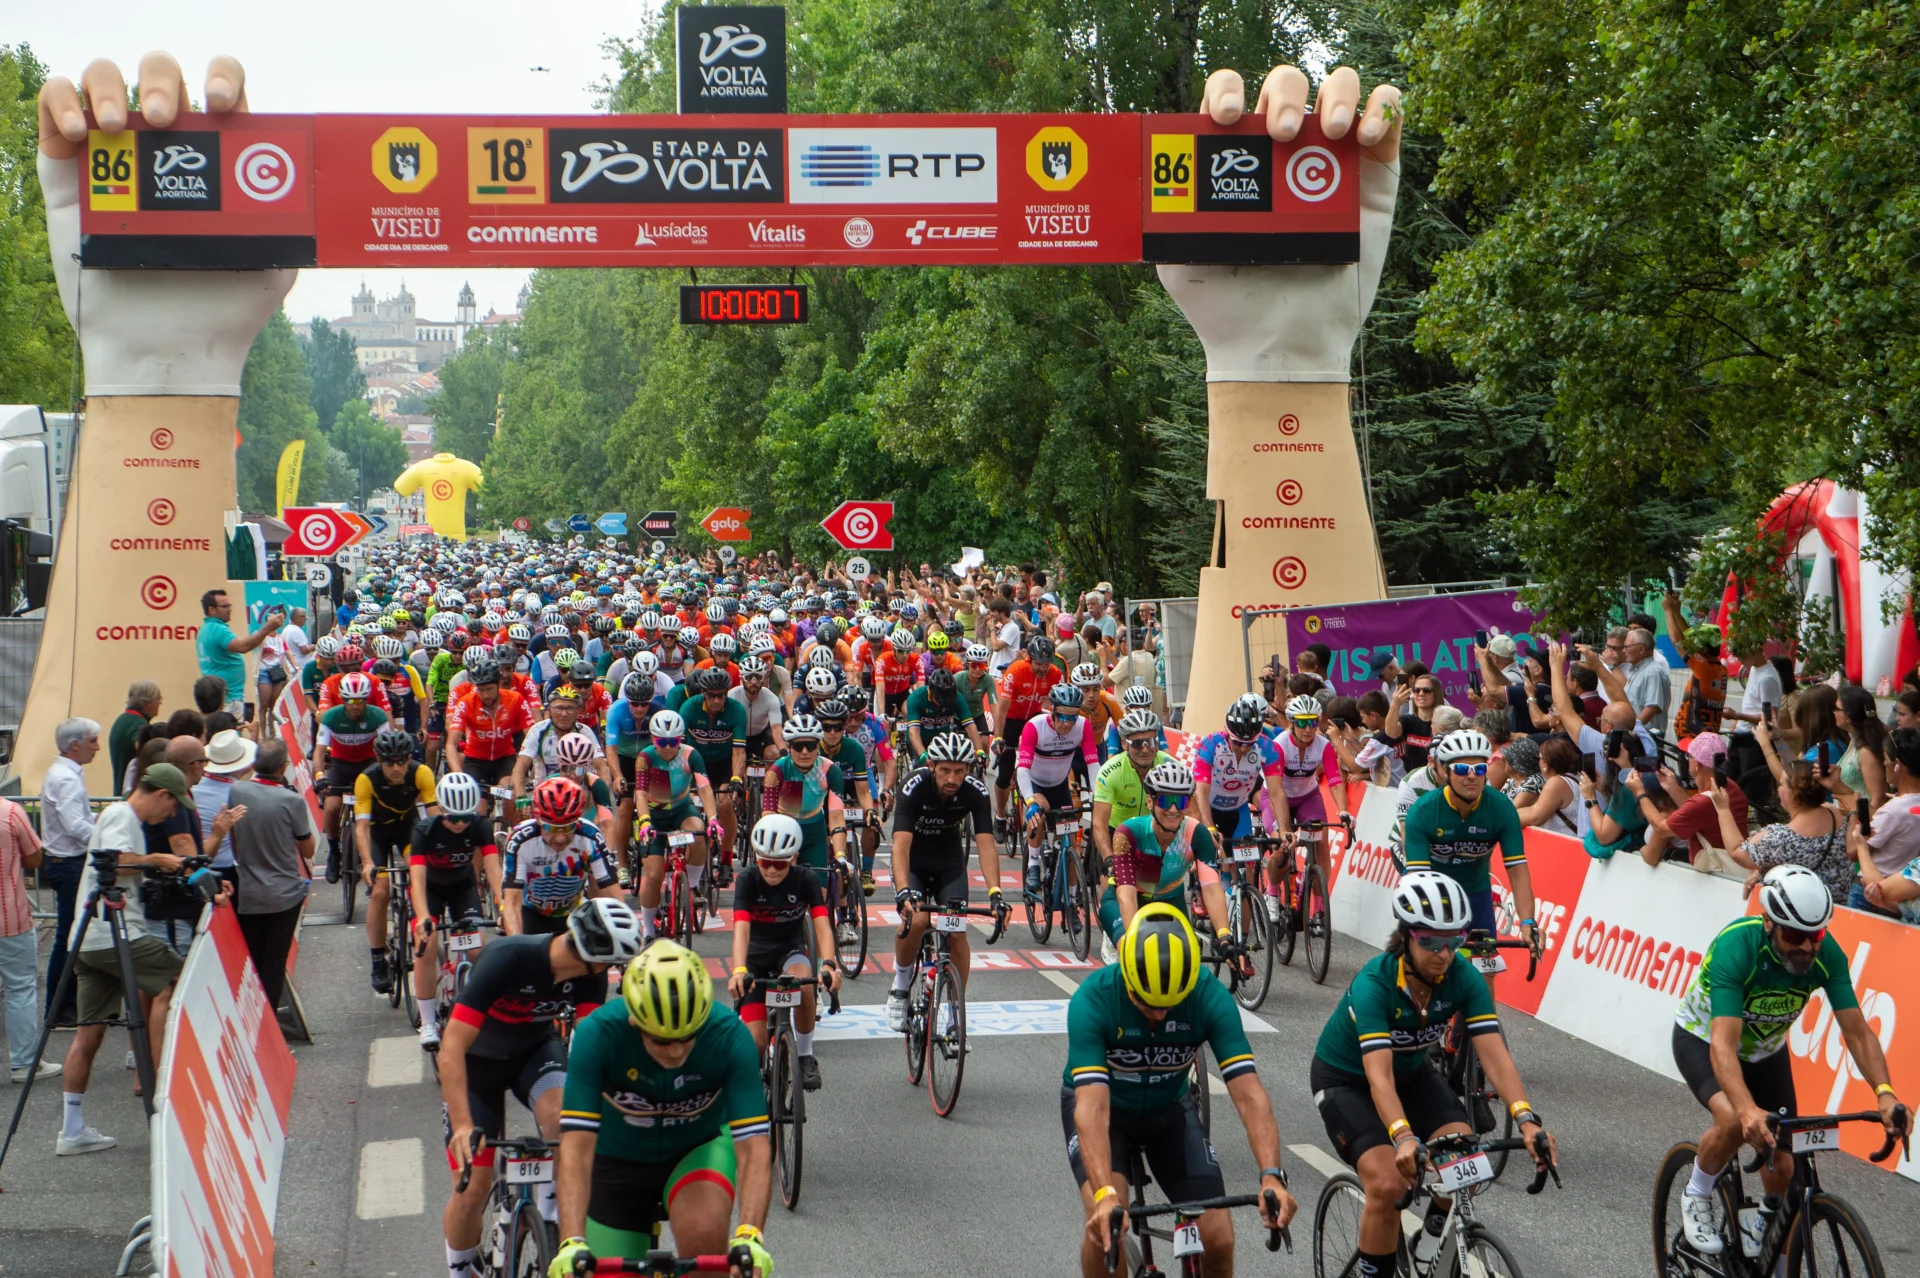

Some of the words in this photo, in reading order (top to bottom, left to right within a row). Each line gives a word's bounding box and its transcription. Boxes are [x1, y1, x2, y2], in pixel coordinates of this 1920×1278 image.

[699, 66, 768, 86] VOLTA
[700, 87, 709, 96] A
[711, 86, 768, 96] PORTUGAL
[652, 141, 726, 156] ETAPA
[738, 141, 768, 156] DA
[888, 154, 985, 177] RTP
[653, 159, 772, 190] VOLTA
[154, 175, 208, 190] VOLTA
[1211, 178, 1259, 192] VOLTA
[163, 190, 208, 199] PORTUGAL
[1219, 192, 1259, 200] PORTUGAL
[371, 205, 424, 215] MUNICÍPIO
[1025, 203, 1075, 213] MUNICÍPIO
[371, 218, 441, 238] VISEU
[645, 222, 708, 238] Lusíadas
[1025, 215, 1090, 234] VISEU
[467, 226, 598, 243] CONTINENTE
[748, 220, 806, 242] Vitalis
[927, 227, 998, 238] CUBE
[700, 290, 799, 320] 10:00:07
[1253, 443, 1324, 452] CONTINENTE
[123, 458, 200, 469] CONTINENTE
[645, 520, 669, 529] PLACARD
[710, 517, 740, 532] galp
[1242, 517, 1336, 529] CONTINENTE
[110, 538, 210, 551] CONTINENTE
[340, 554, 350, 563] 50
[722, 550, 732, 558] 50
[852, 563, 865, 574] 25
[312, 569, 325, 581] 25
[96, 625, 199, 640] CONTINEN
[476, 727, 511, 739] galp
[918, 815, 944, 825] Euro
[914, 824, 941, 835] Trips
[1063, 823, 1071, 831] 22
[507, 825, 534, 854] RTP
[1240, 849, 1252, 857] 155
[1454, 845, 1488, 853] VOLTA
[1348, 839, 1400, 891] CONTI
[945, 917, 960, 928] 340
[458, 936, 472, 946] 815
[1572, 915, 1703, 1000] CONTINENT
[1481, 958, 1497, 970] 349
[775, 993, 791, 1003] 843
[1144, 1051, 1196, 1065] VOLTA
[1805, 1130, 1826, 1145] 762
[519, 1162, 540, 1177] 816
[1454, 1160, 1478, 1181] 348
